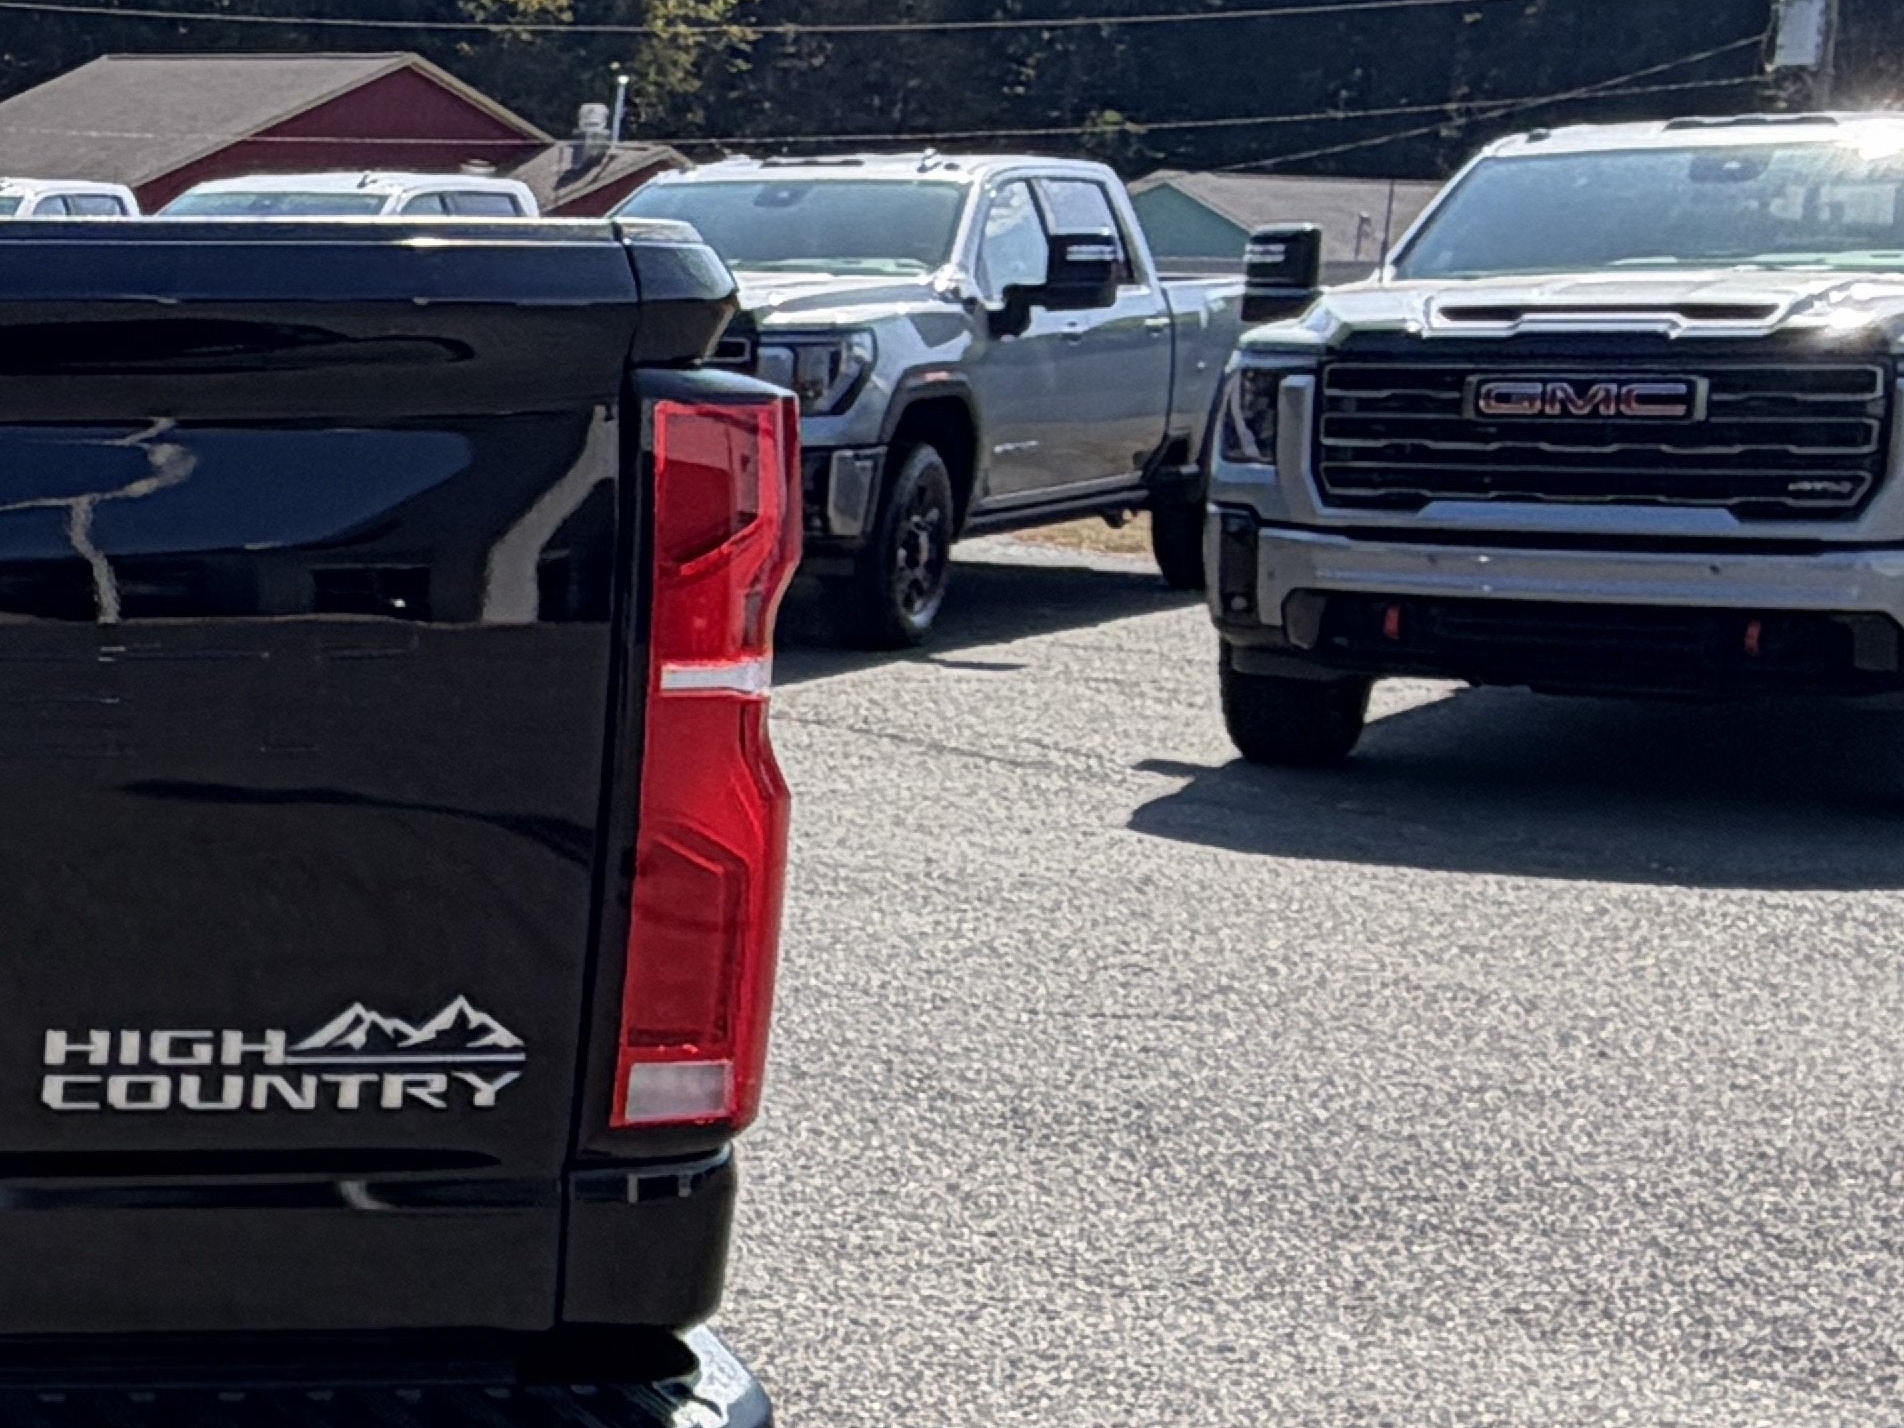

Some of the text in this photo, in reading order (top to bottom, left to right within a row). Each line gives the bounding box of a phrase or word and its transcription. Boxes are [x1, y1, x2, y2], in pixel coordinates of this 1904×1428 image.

[1478, 382, 1688, 416] GMC
[44, 1028, 287, 1065] HIGH
[41, 1072, 522, 1110] COUNTRY
